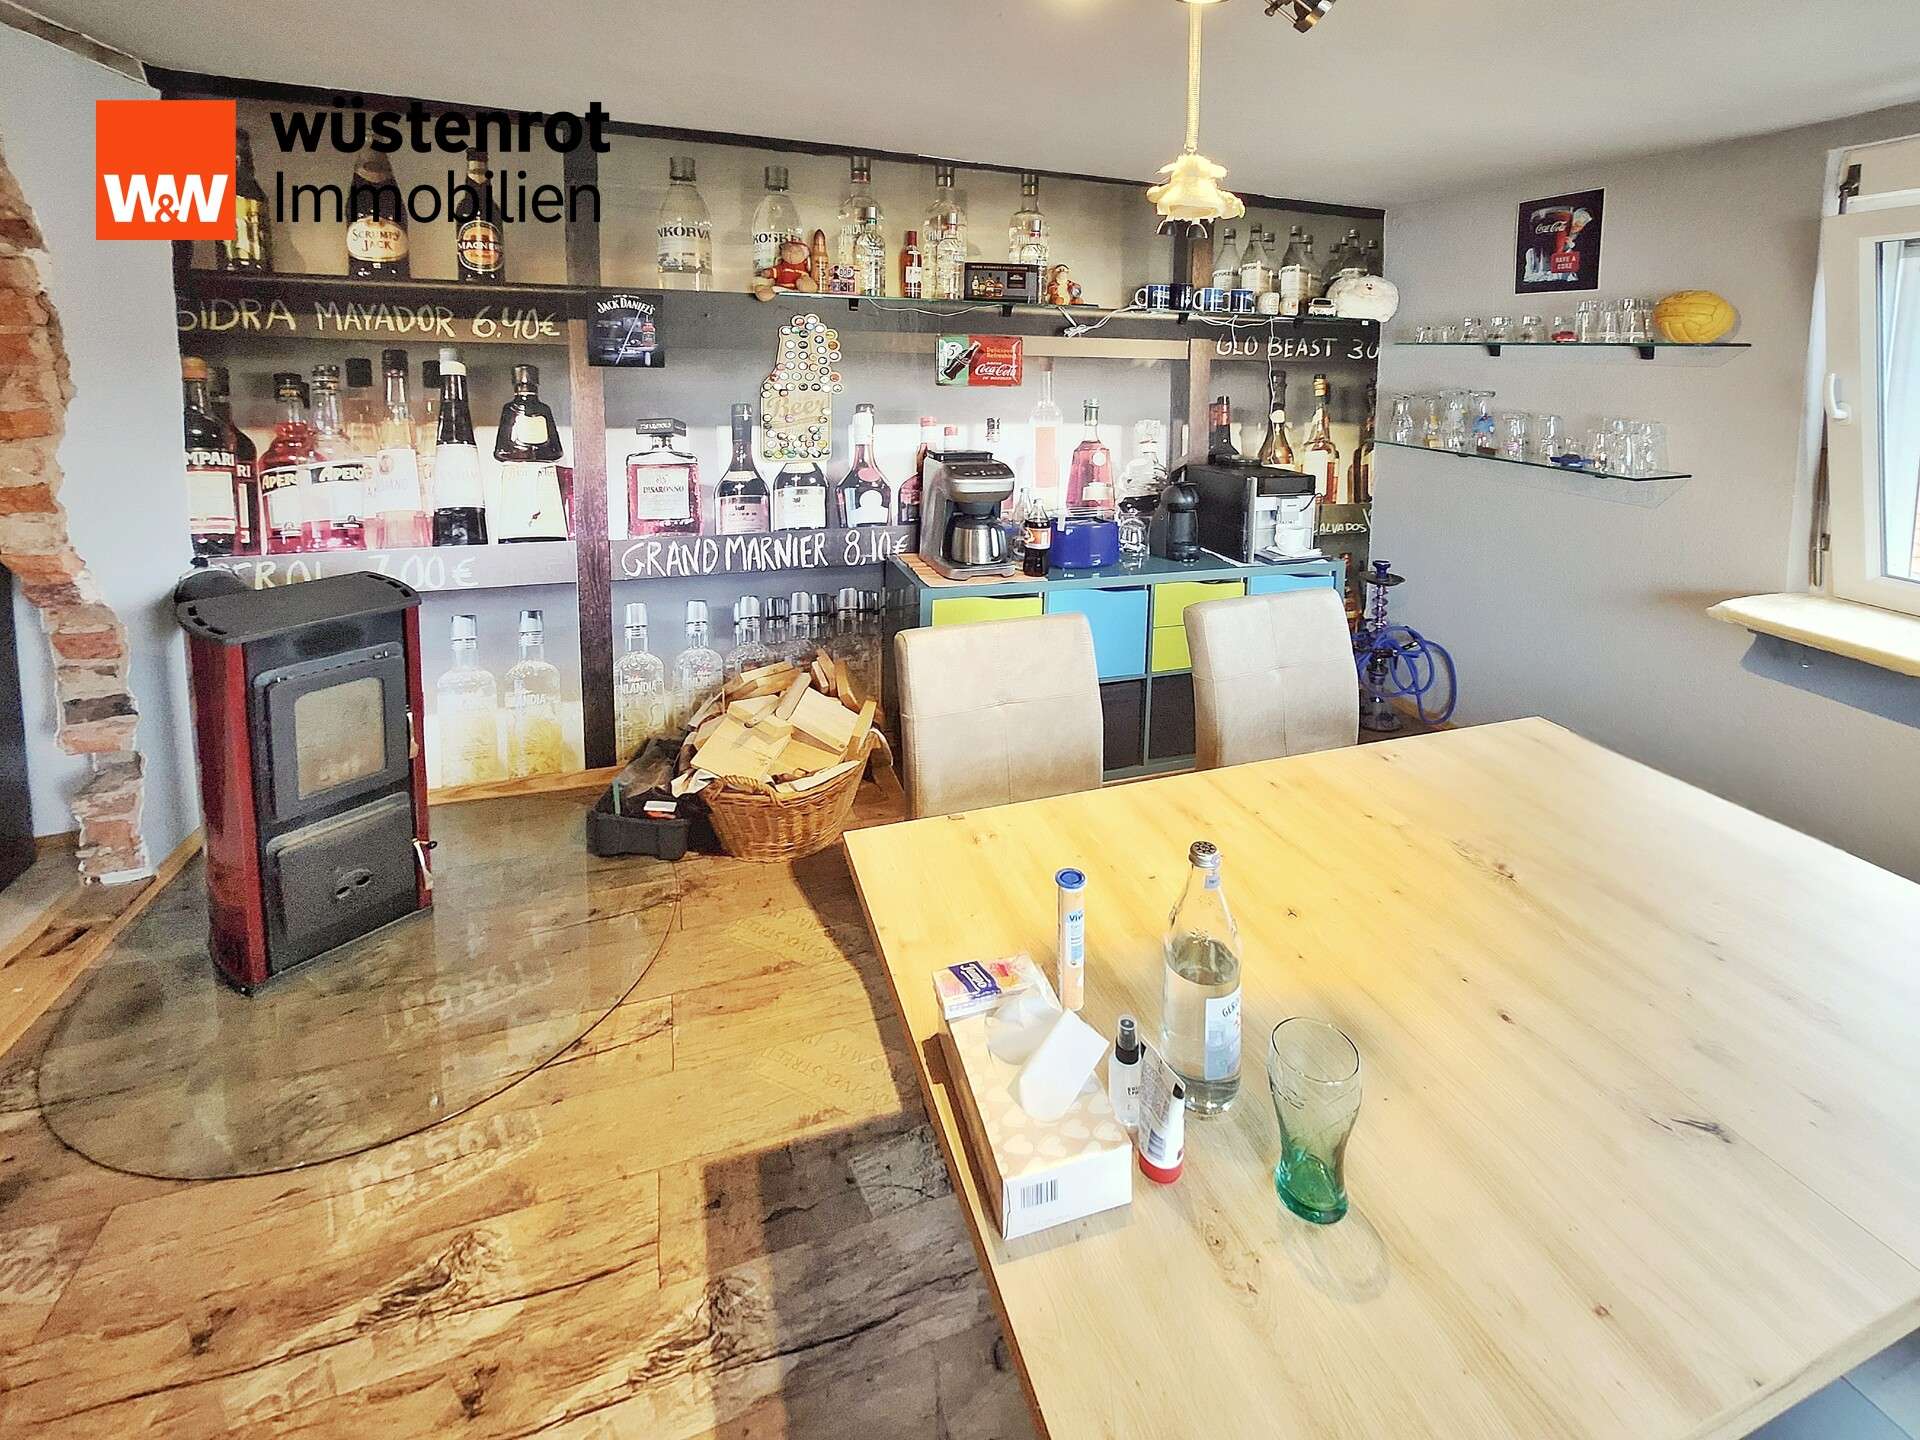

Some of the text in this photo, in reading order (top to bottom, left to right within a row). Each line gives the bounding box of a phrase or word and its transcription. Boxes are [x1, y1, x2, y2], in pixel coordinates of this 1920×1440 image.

[596, 297, 656, 315] JACK DANIEL'S
[314, 301, 457, 338] MAYADOR
[1267, 336, 1338, 358] BEAST
[642, 484, 685, 495] DISARONNO
[1313, 522, 1368, 536] ALVADOS
[621, 538, 719, 577] GRAND
[724, 531, 829, 572] MARNIER
